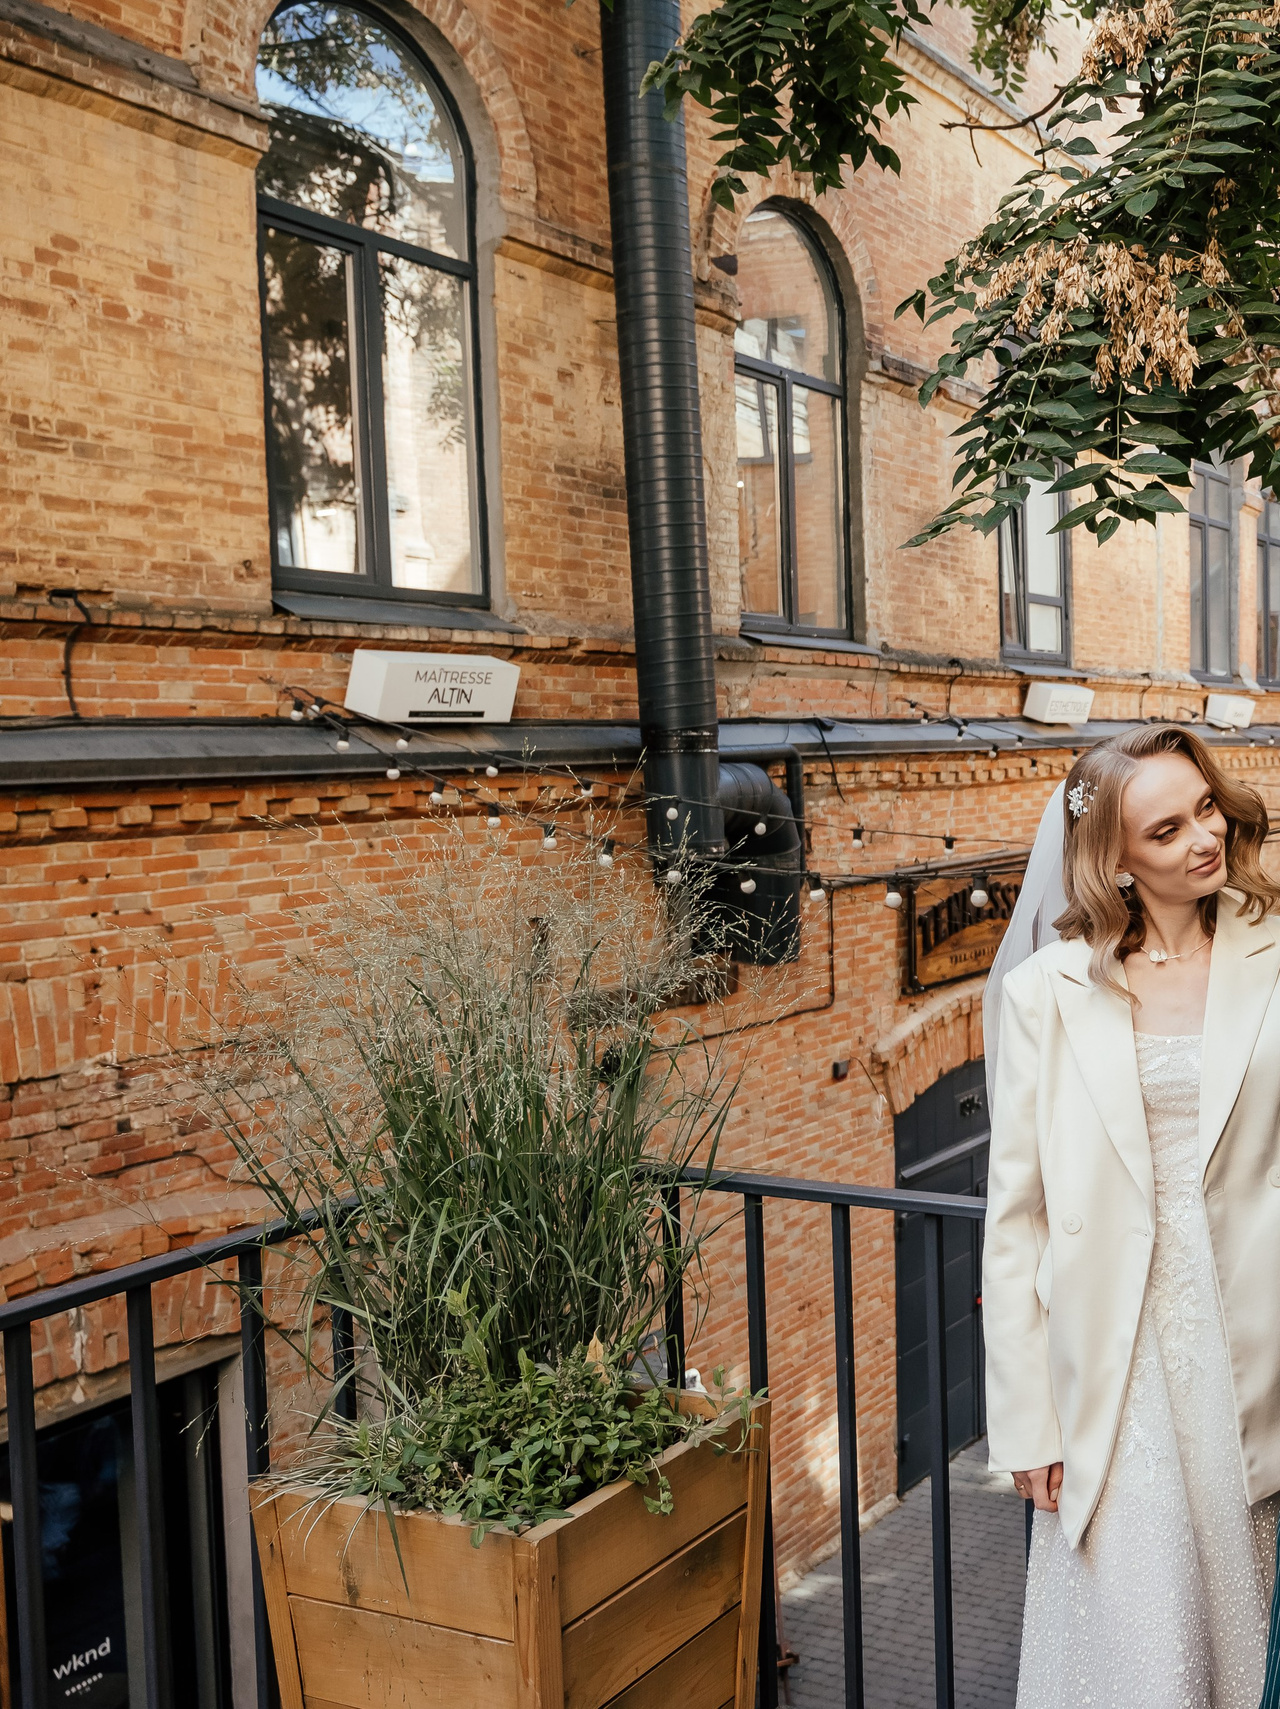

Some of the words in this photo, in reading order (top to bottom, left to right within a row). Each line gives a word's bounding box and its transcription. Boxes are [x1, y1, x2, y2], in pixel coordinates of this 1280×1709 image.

[415, 668, 493, 684] MAÎTRESSE
[428, 687, 473, 707] ALTIN
[53, 1636, 111, 1680] wknd
